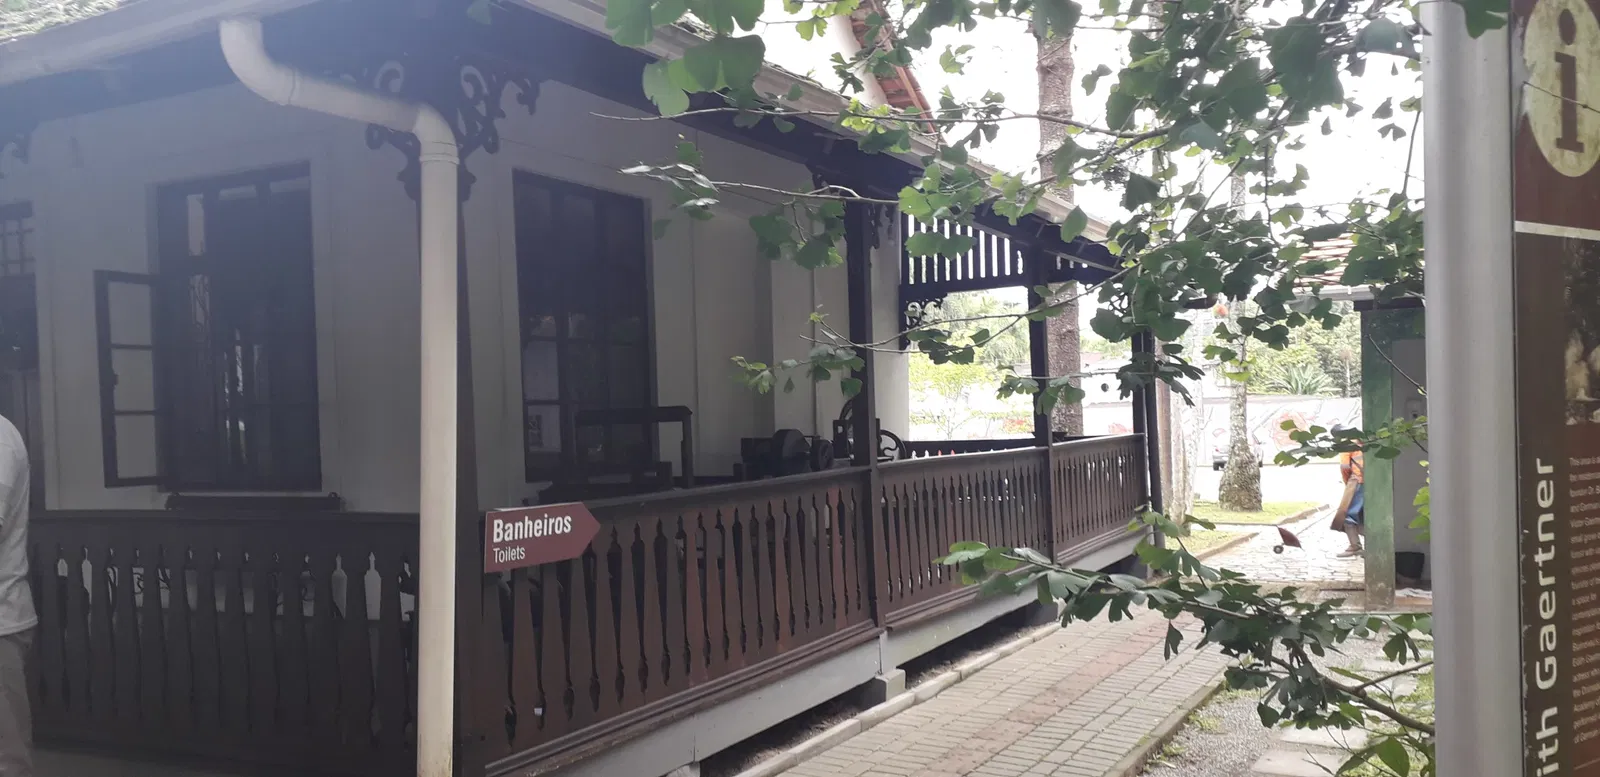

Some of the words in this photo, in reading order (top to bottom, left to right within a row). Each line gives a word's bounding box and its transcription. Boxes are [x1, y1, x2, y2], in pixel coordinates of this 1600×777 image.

[493, 513, 572, 543] Banheiros
[493, 545, 526, 563] Toilets
[1534, 457, 1558, 689] Gaertner
